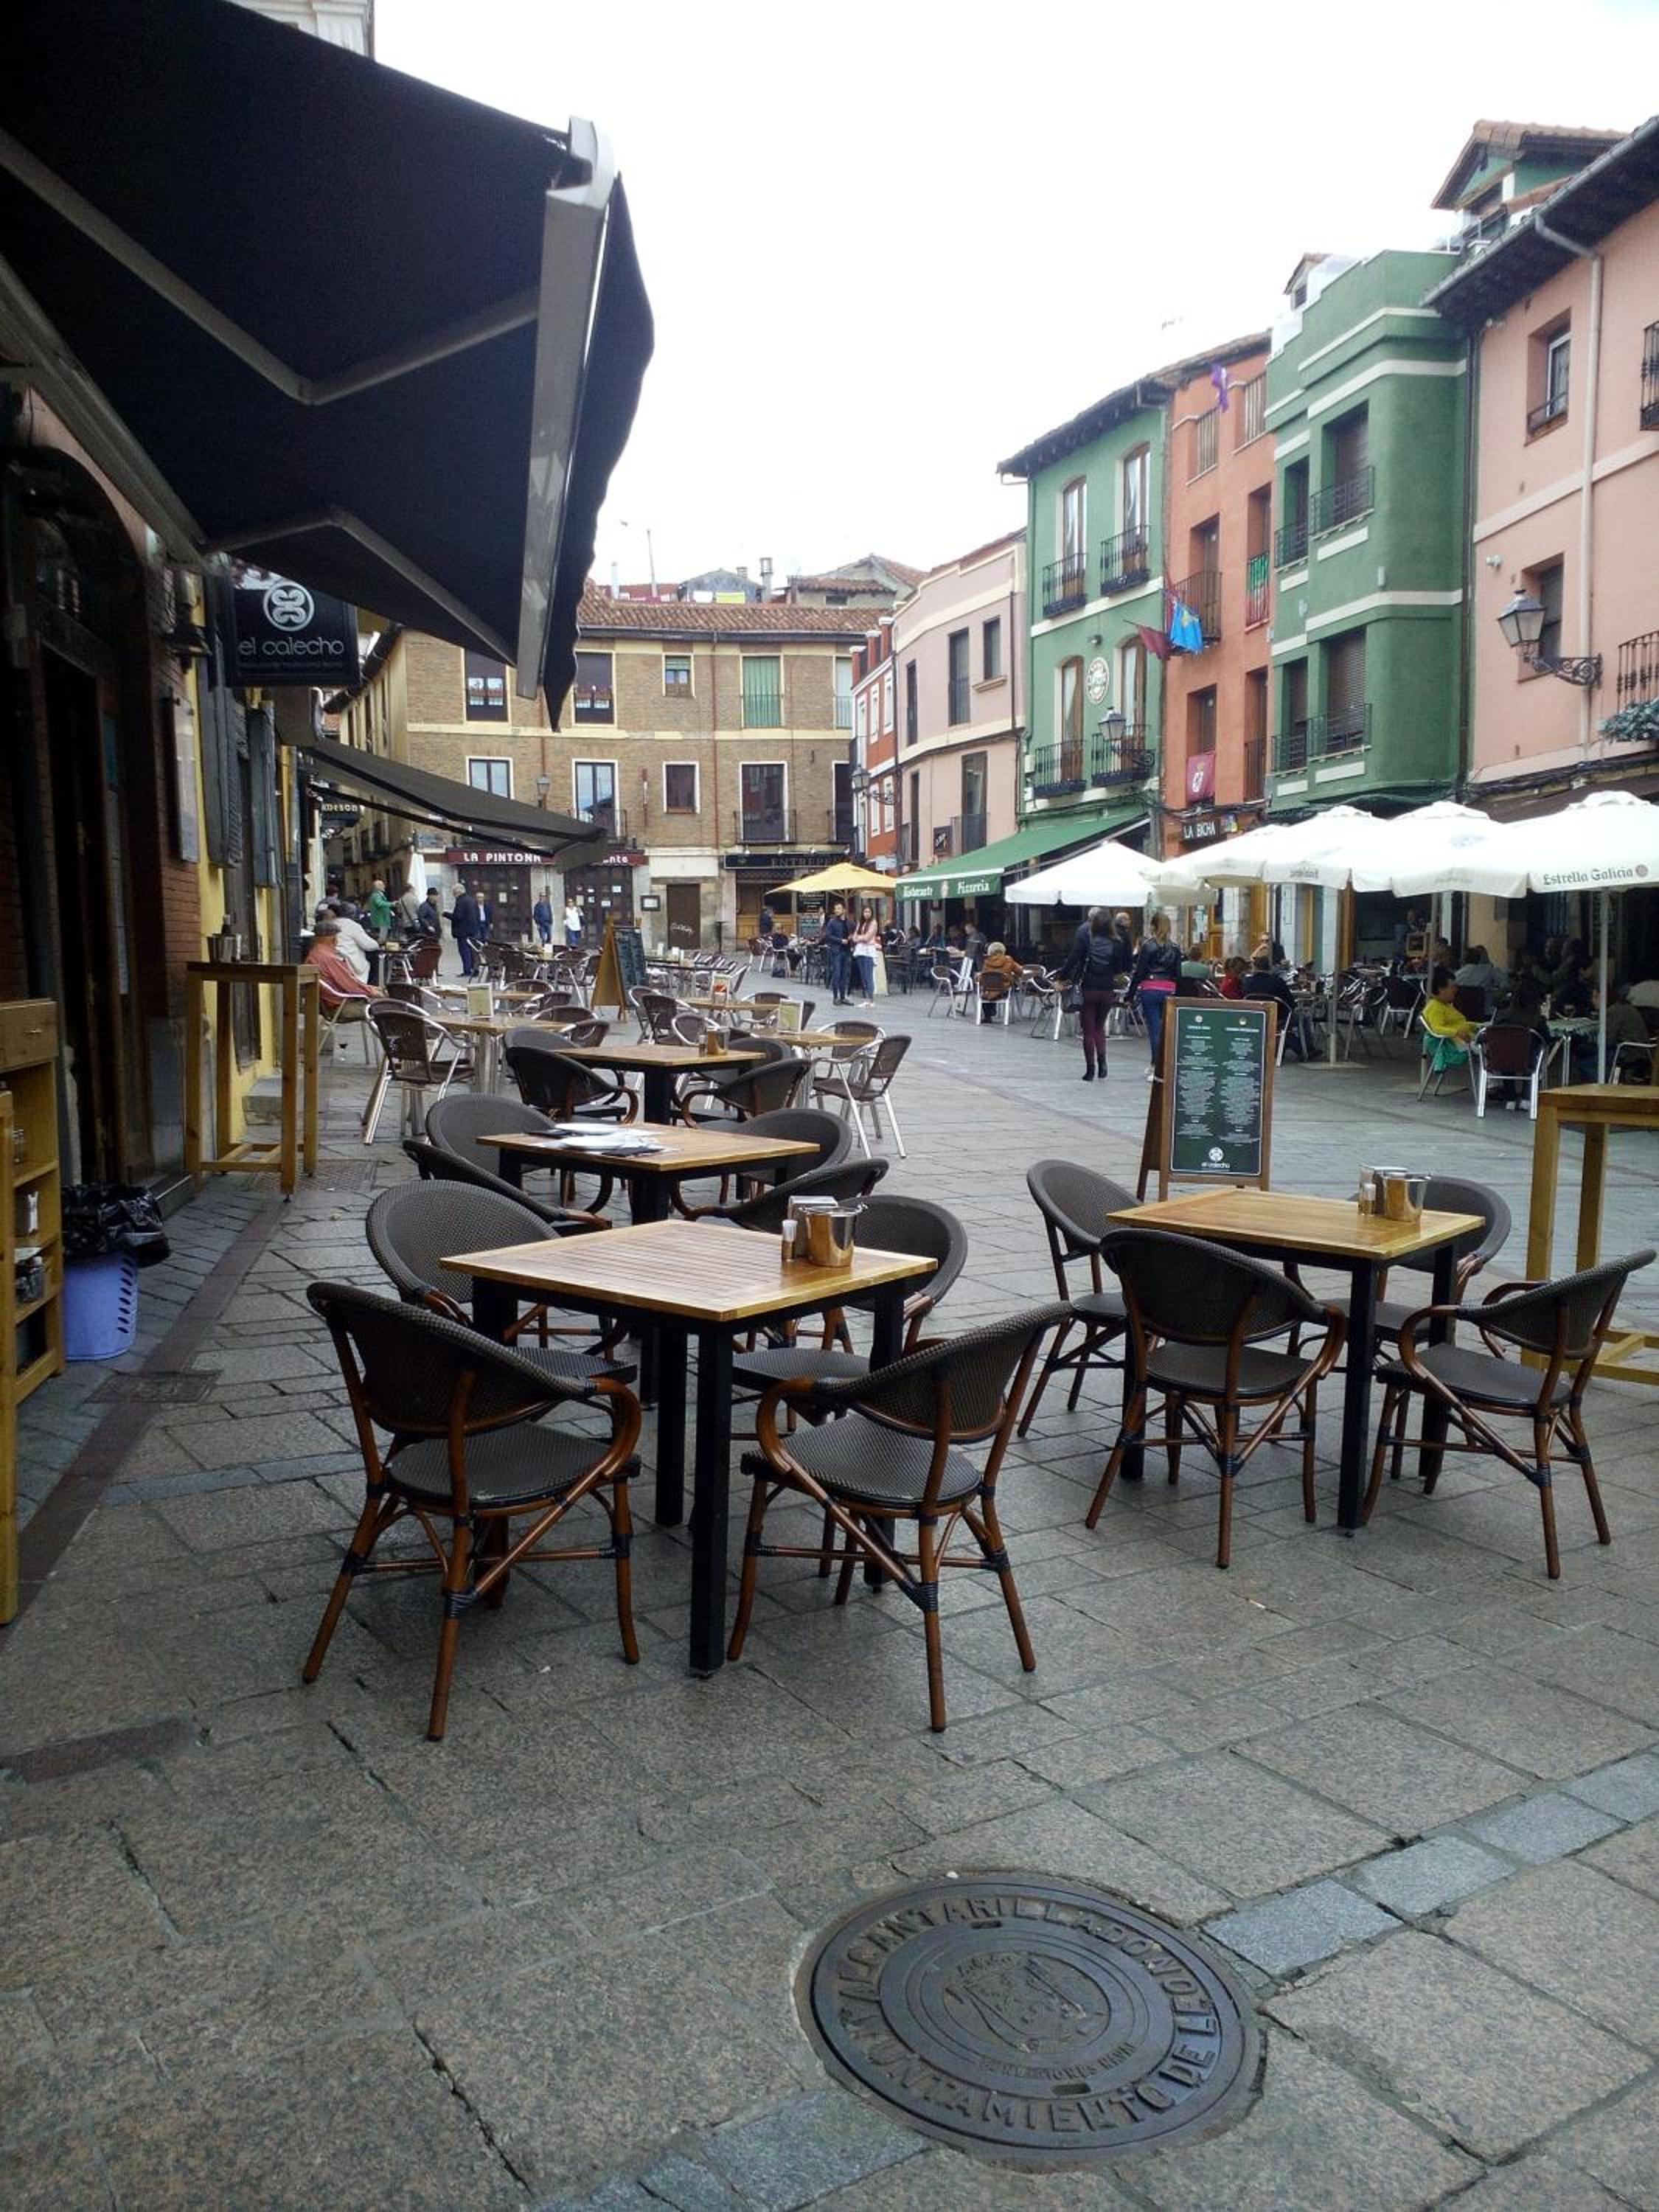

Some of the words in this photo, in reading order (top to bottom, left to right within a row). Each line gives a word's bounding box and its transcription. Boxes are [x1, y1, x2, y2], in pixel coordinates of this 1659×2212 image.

[238, 636, 257, 655] el
[262, 636, 344, 655] calecho
[1183, 825, 1194, 838] LA
[1197, 821, 1216, 837] BICHA
[463, 852, 479, 862] LA
[486, 852, 542, 862] PINTONA
[1543, 871, 1589, 886] Estrella
[1591, 866, 1633, 881] Galicia
[957, 878, 990, 894] Pizzeria
[838, 1898, 1148, 2000] ALCANTARILLADO
[839, 2003, 1178, 2133] AYUNTAMIENTO
[1158, 2045, 1217, 2089] DE
